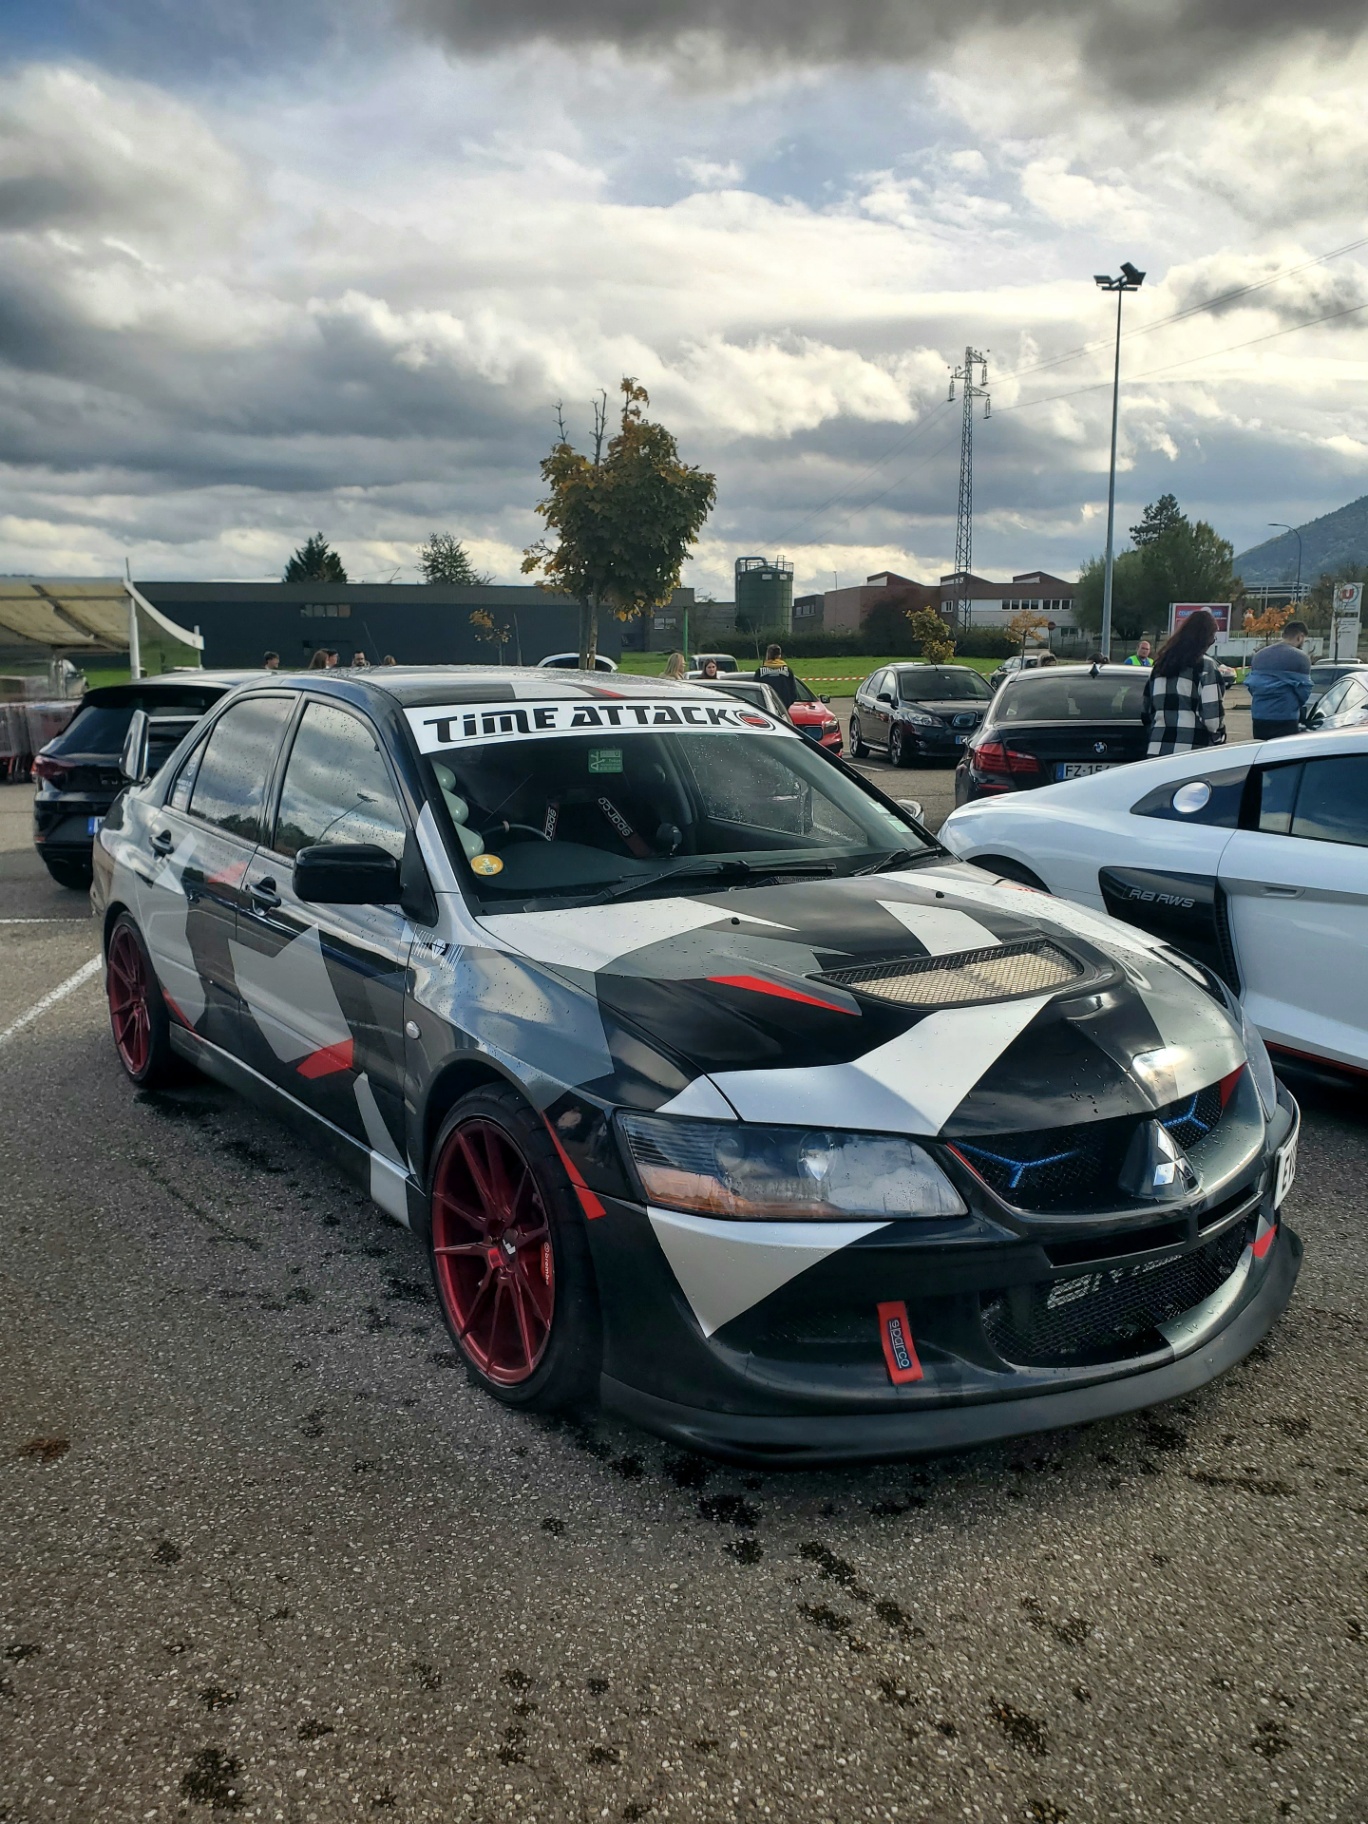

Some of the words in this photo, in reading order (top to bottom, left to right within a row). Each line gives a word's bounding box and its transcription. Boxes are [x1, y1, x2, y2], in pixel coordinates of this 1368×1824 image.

[570, 705, 742, 727] ATTACK
[1065, 764, 1109, 777] FZ-15
[544, 806, 557, 841] sparc
[598, 797, 633, 837] sparco
[1129, 888, 1156, 901] R8
[1156, 893, 1196, 908] RWS
[889, 1319, 910, 1369] sparco
